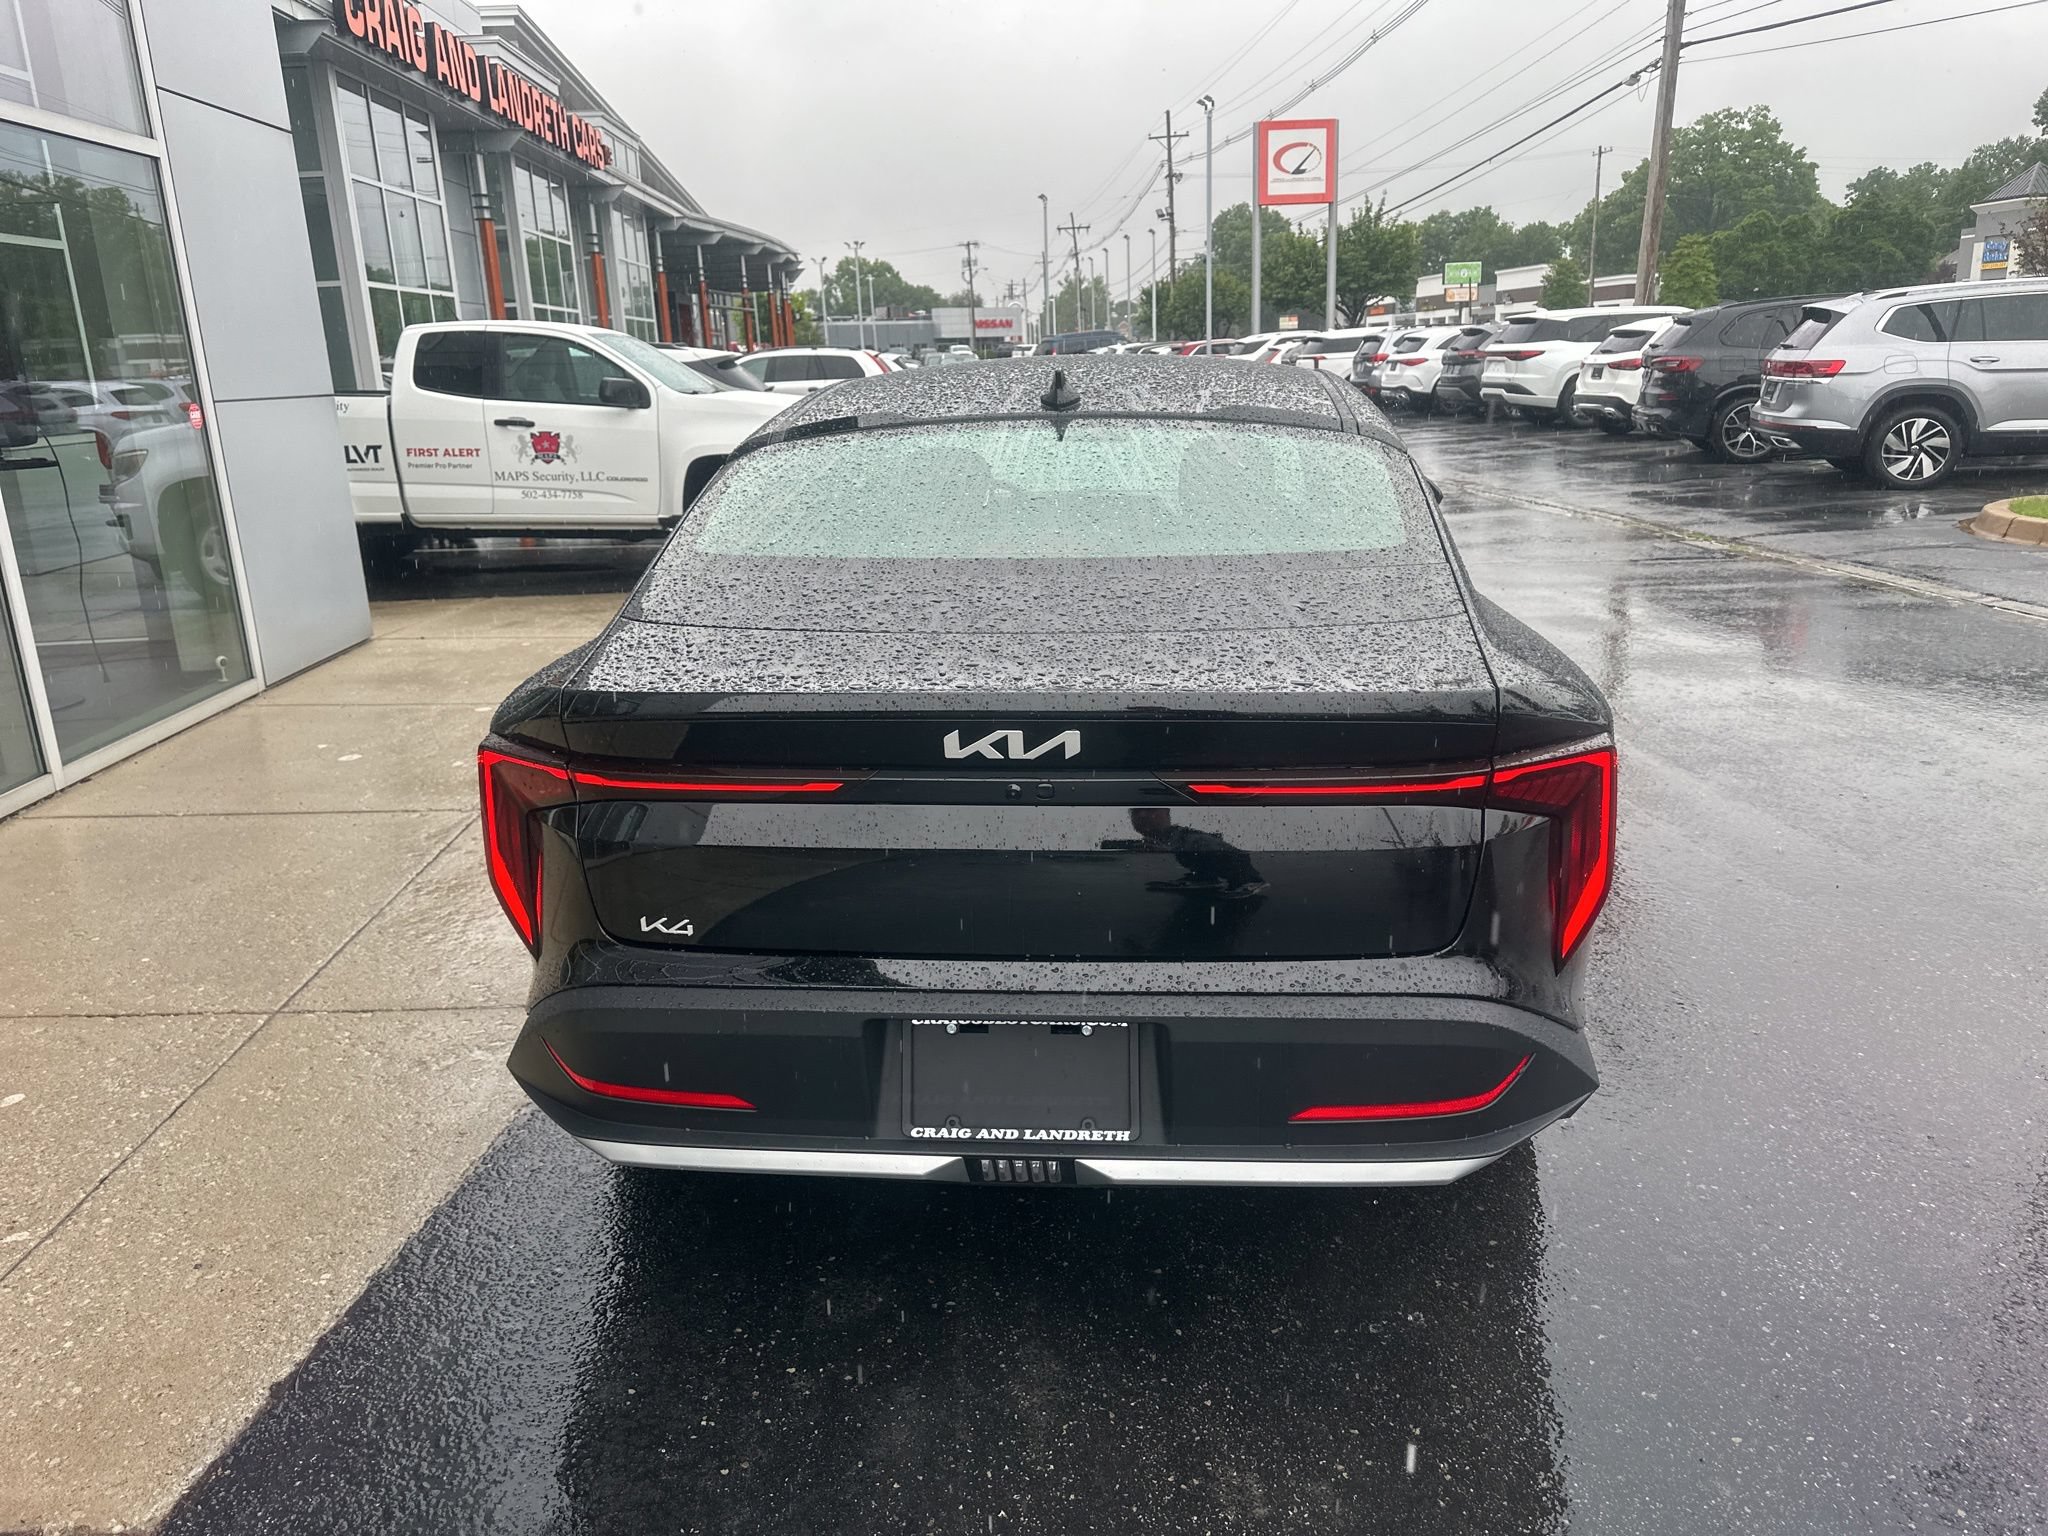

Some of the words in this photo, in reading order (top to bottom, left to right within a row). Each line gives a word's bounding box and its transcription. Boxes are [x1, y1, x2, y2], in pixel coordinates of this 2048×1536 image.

[344, 0, 428, 73] CRAIG
[433, 22, 482, 103] AND
[483, 55, 571, 153] LANDRETH
[572, 112, 605, 171] CARS
[343, 444, 383, 464] LVT
[406, 447, 440, 457] FIRST
[443, 447, 481, 457] ALERT
[434, 462, 447, 470] Pro
[494, 471, 530, 482] MAPS
[532, 470, 579, 485] Security,
[581, 471, 606, 482] LLC
[521, 489, 584, 500] 502-434-7758
[943, 729, 1081, 760] KIA
[639, 915, 694, 937] K4
[910, 1127, 972, 1139] CRAIG
[975, 1128, 1019, 1140] AND
[1023, 1128, 1131, 1142] LANDRETH
